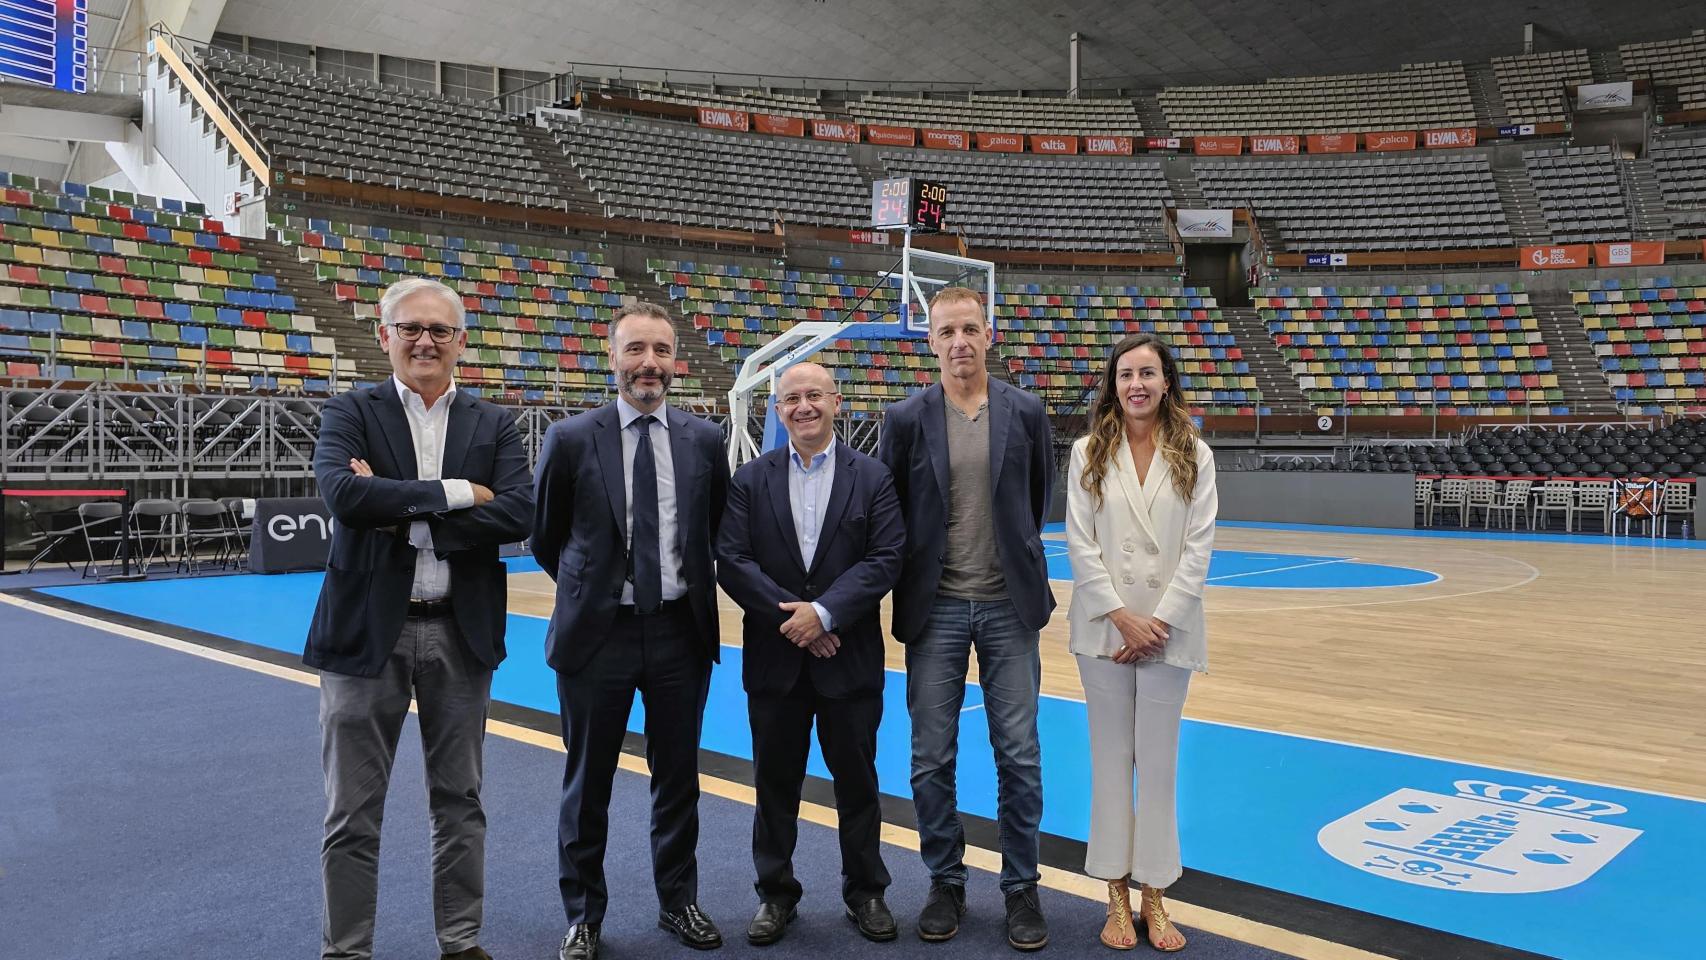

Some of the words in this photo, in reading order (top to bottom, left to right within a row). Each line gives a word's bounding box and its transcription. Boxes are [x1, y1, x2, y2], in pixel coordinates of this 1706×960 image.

[701, 110, 732, 126] LEYMA
[814, 122, 845, 138] LEYMA
[990, 136, 1017, 146] galicia
[1088, 138, 1117, 152] LEYMA
[1253, 138, 1283, 152] LEYMA
[1379, 135, 1408, 145] galicia
[1427, 132, 1459, 146] LEYMA
[881, 181, 908, 197] 2:00
[921, 183, 946, 203] 2:00
[878, 199, 902, 221] 24
[917, 200, 941, 224] 24
[1611, 247, 1629, 256] GBS
[1321, 418, 1329, 428] 2
[267, 513, 334, 542] en
